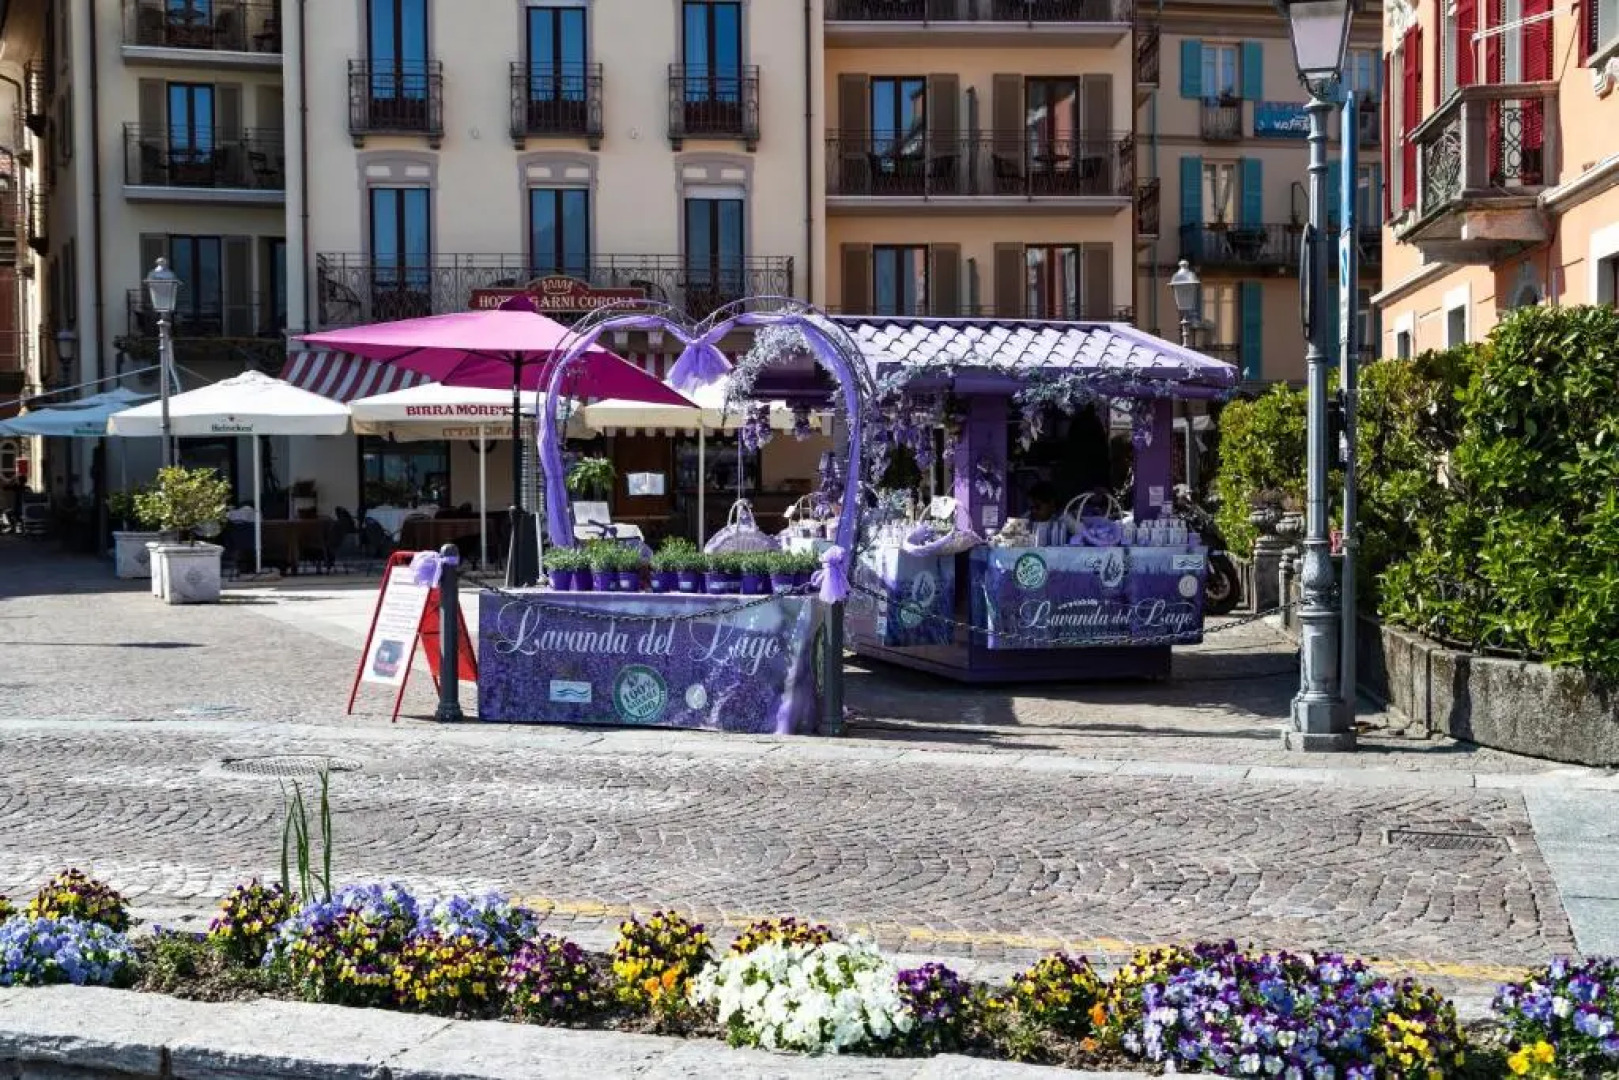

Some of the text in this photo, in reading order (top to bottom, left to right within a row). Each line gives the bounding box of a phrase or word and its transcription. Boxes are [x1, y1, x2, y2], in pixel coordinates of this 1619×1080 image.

[479, 295, 516, 308] HOT
[579, 295, 637, 308] CORONA
[406, 404, 509, 416] BIRRA MORET
[1019, 597, 1193, 633] Lavanda del Lago
[495, 600, 780, 676] Lavanda del Lago
